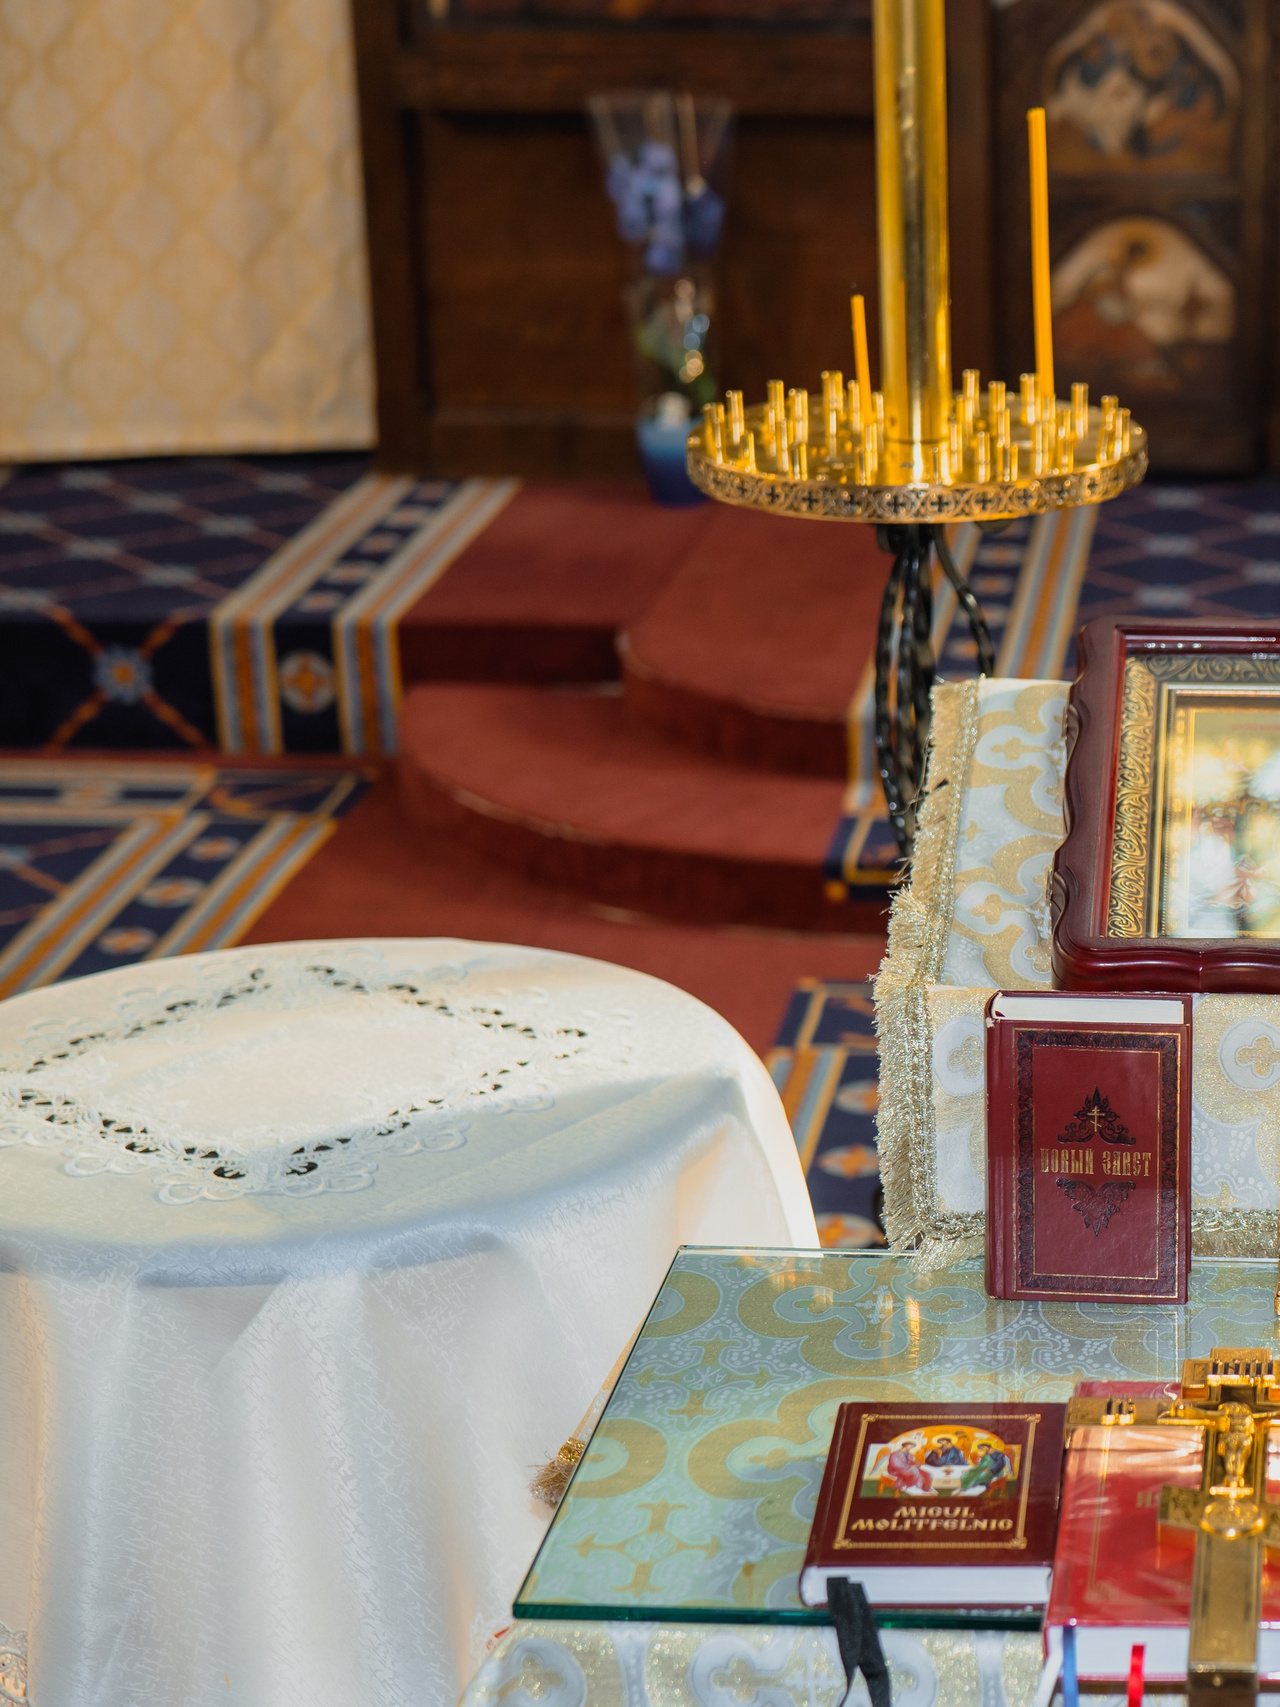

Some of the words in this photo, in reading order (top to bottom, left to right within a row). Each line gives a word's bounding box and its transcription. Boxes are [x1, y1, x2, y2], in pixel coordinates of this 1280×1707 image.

[1040, 1148, 1094, 1175] НОВЫЙ
[1102, 1151, 1151, 1176] ЗАВЕТ
[894, 1506, 975, 1518] MICUL
